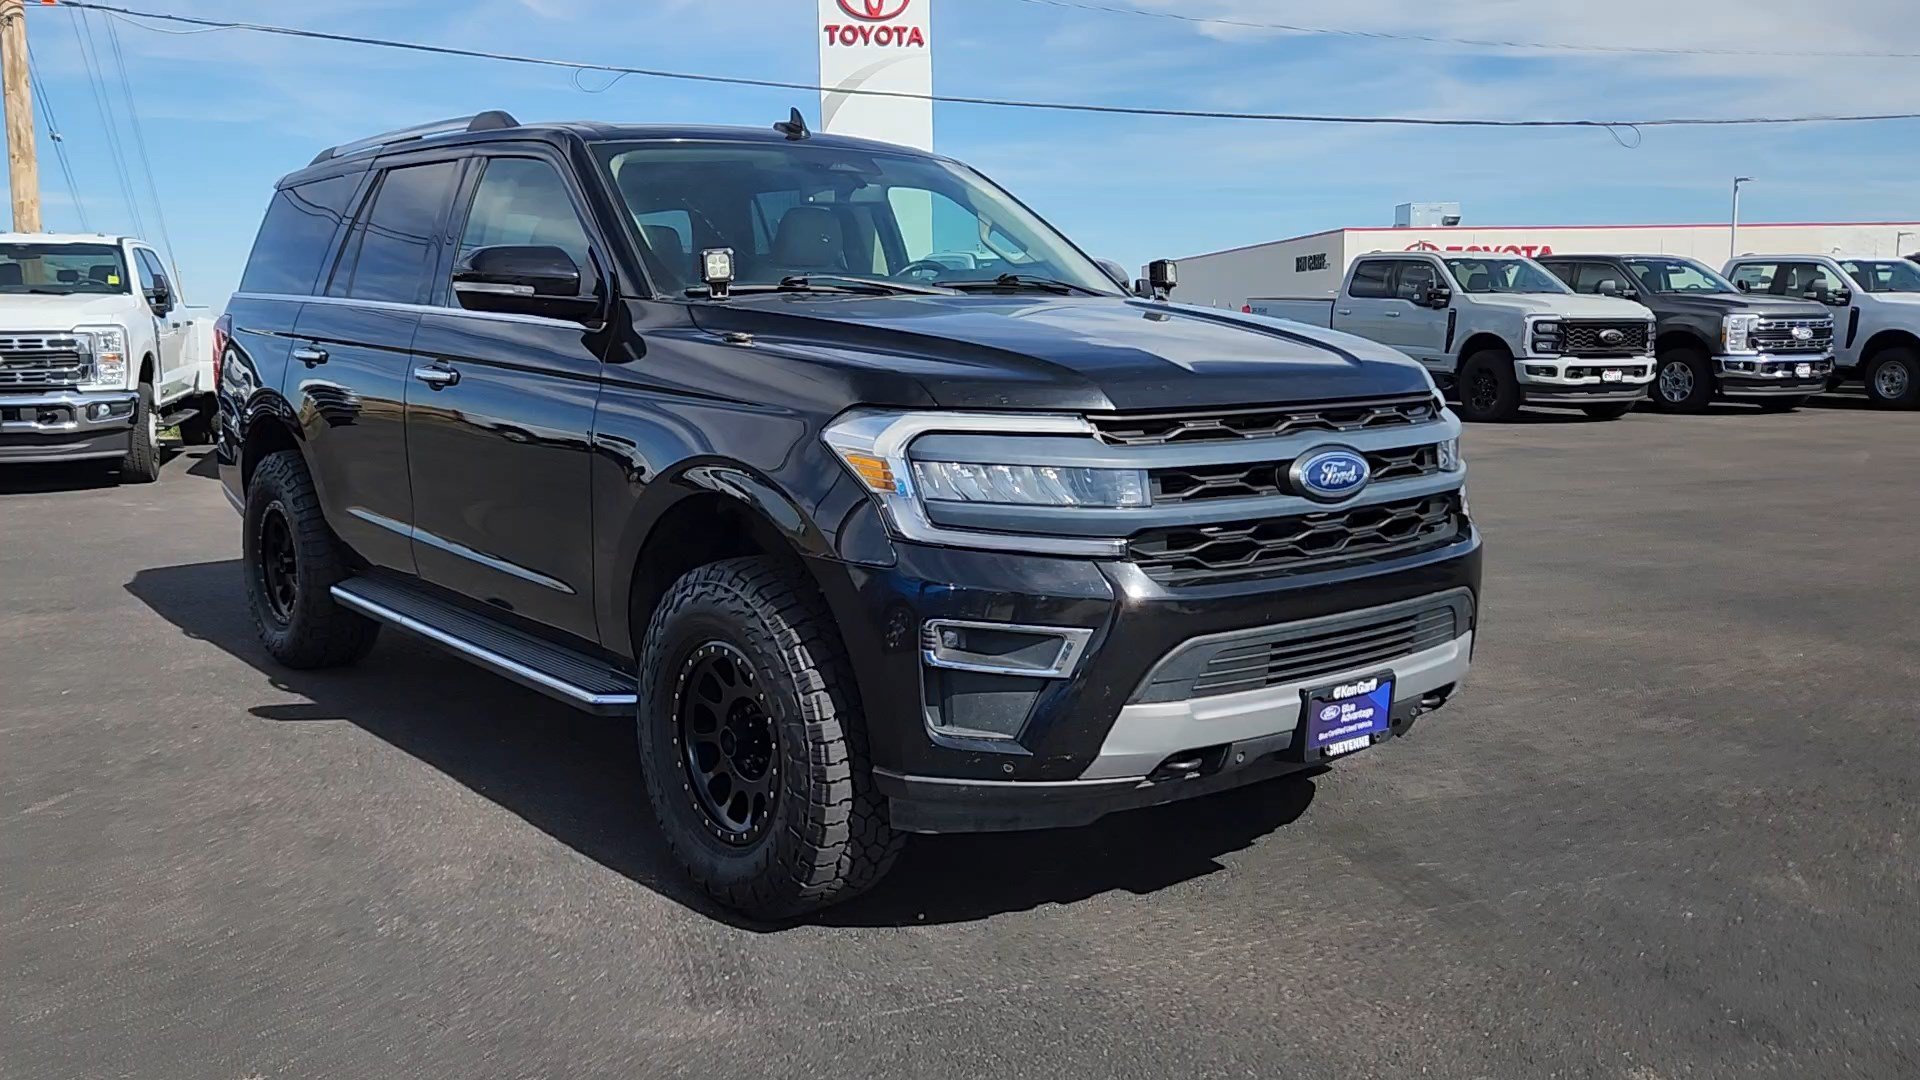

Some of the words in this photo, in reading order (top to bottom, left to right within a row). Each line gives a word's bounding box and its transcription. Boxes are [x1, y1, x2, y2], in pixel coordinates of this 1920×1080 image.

[823, 25, 925, 47] TOYOTA
[1446, 245, 1552, 258] OTA
[1320, 461, 1357, 486] Ford
[1341, 708, 1374, 723] Advantage
[1325, 735, 1370, 756] CHEYENNE
